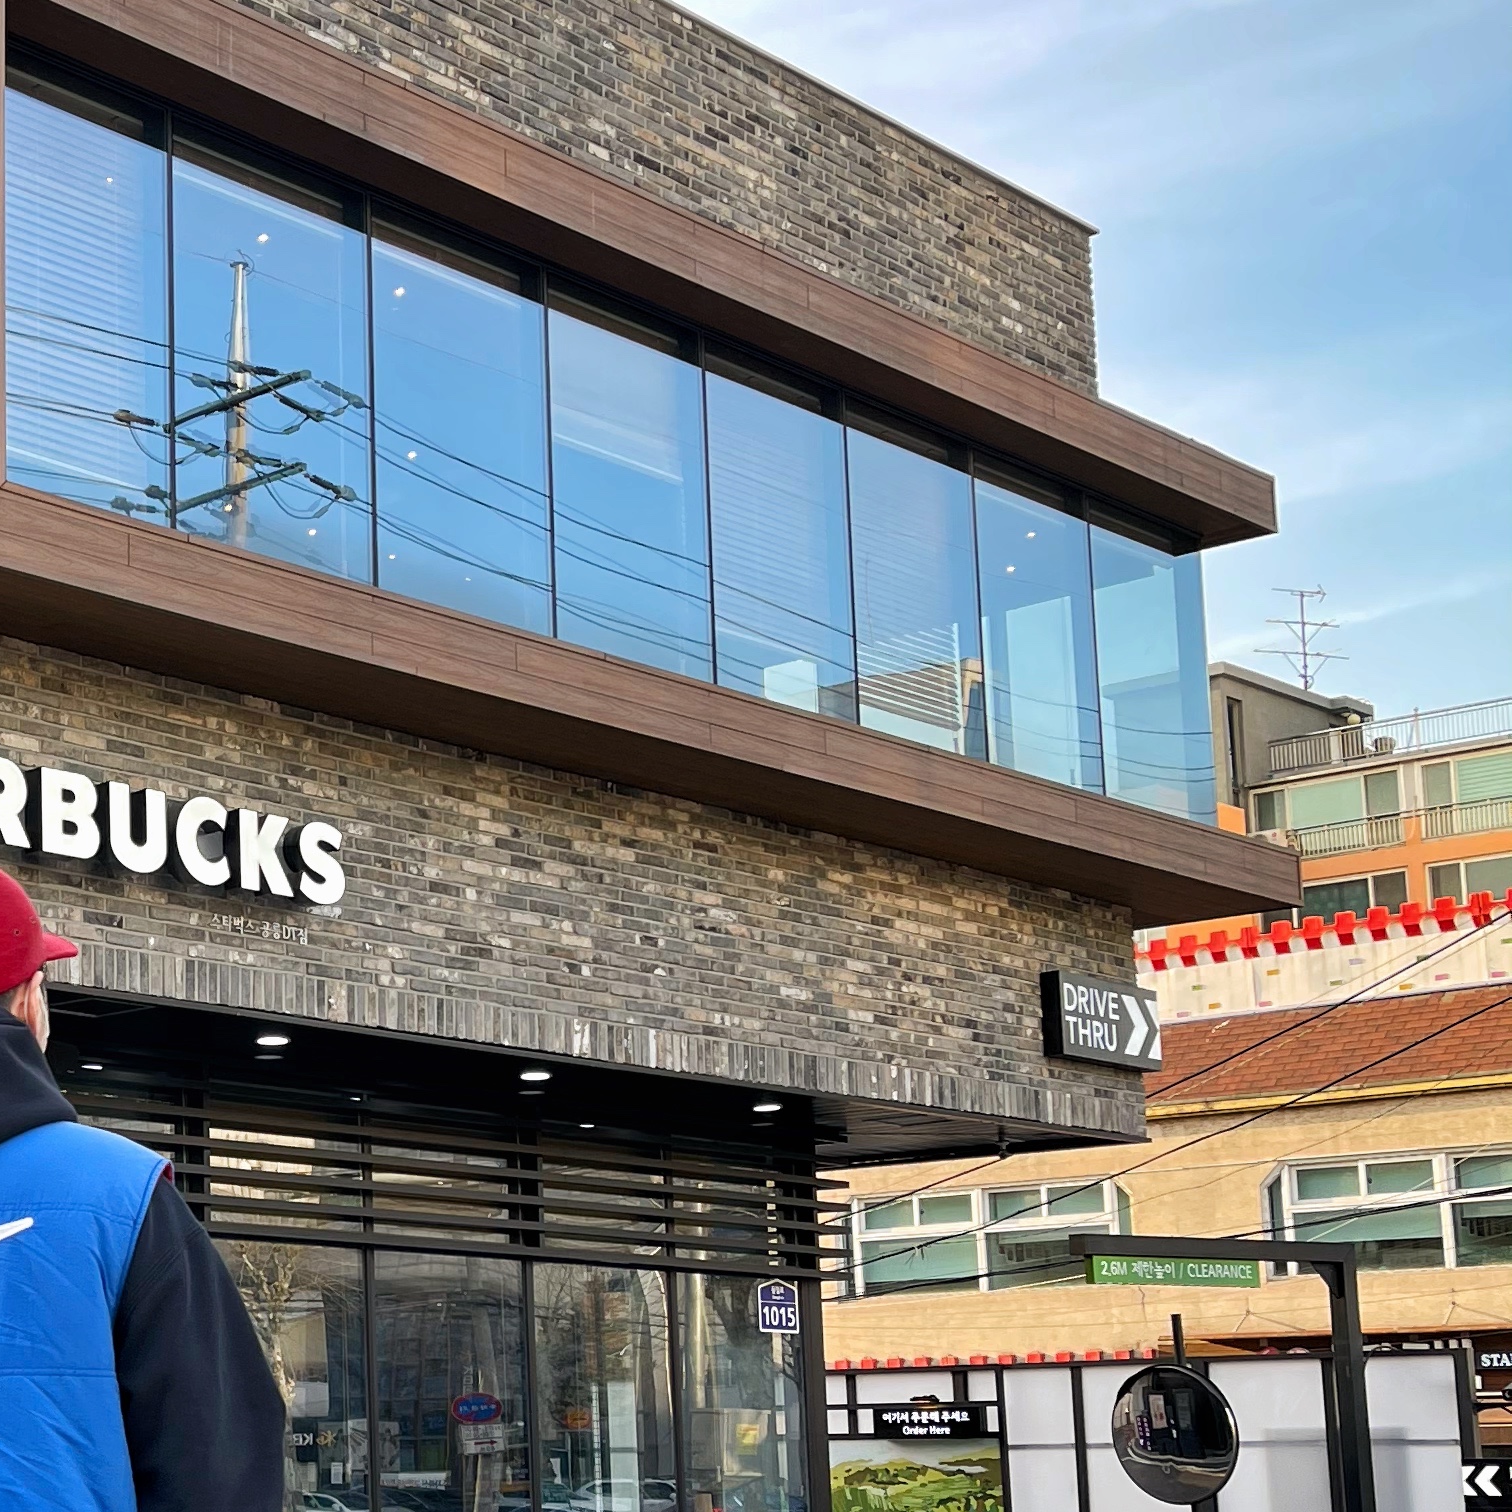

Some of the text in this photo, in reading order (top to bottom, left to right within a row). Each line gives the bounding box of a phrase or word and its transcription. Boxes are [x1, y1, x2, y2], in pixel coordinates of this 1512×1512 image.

[210, 913, 260, 935] 스타벅스
[1063, 982, 1120, 1020] DRIVE
[1065, 1015, 1118, 1052] THRU
[1100, 1260, 1128, 1277] 2.6M
[1131, 1261, 1176, 1279] 제한높이
[1187, 1263, 1253, 1280] CLEARANCE
[762, 1305, 796, 1327] 1015
[1480, 1353, 1512, 1367] STA
[902, 1425, 951, 1435] Order Here
